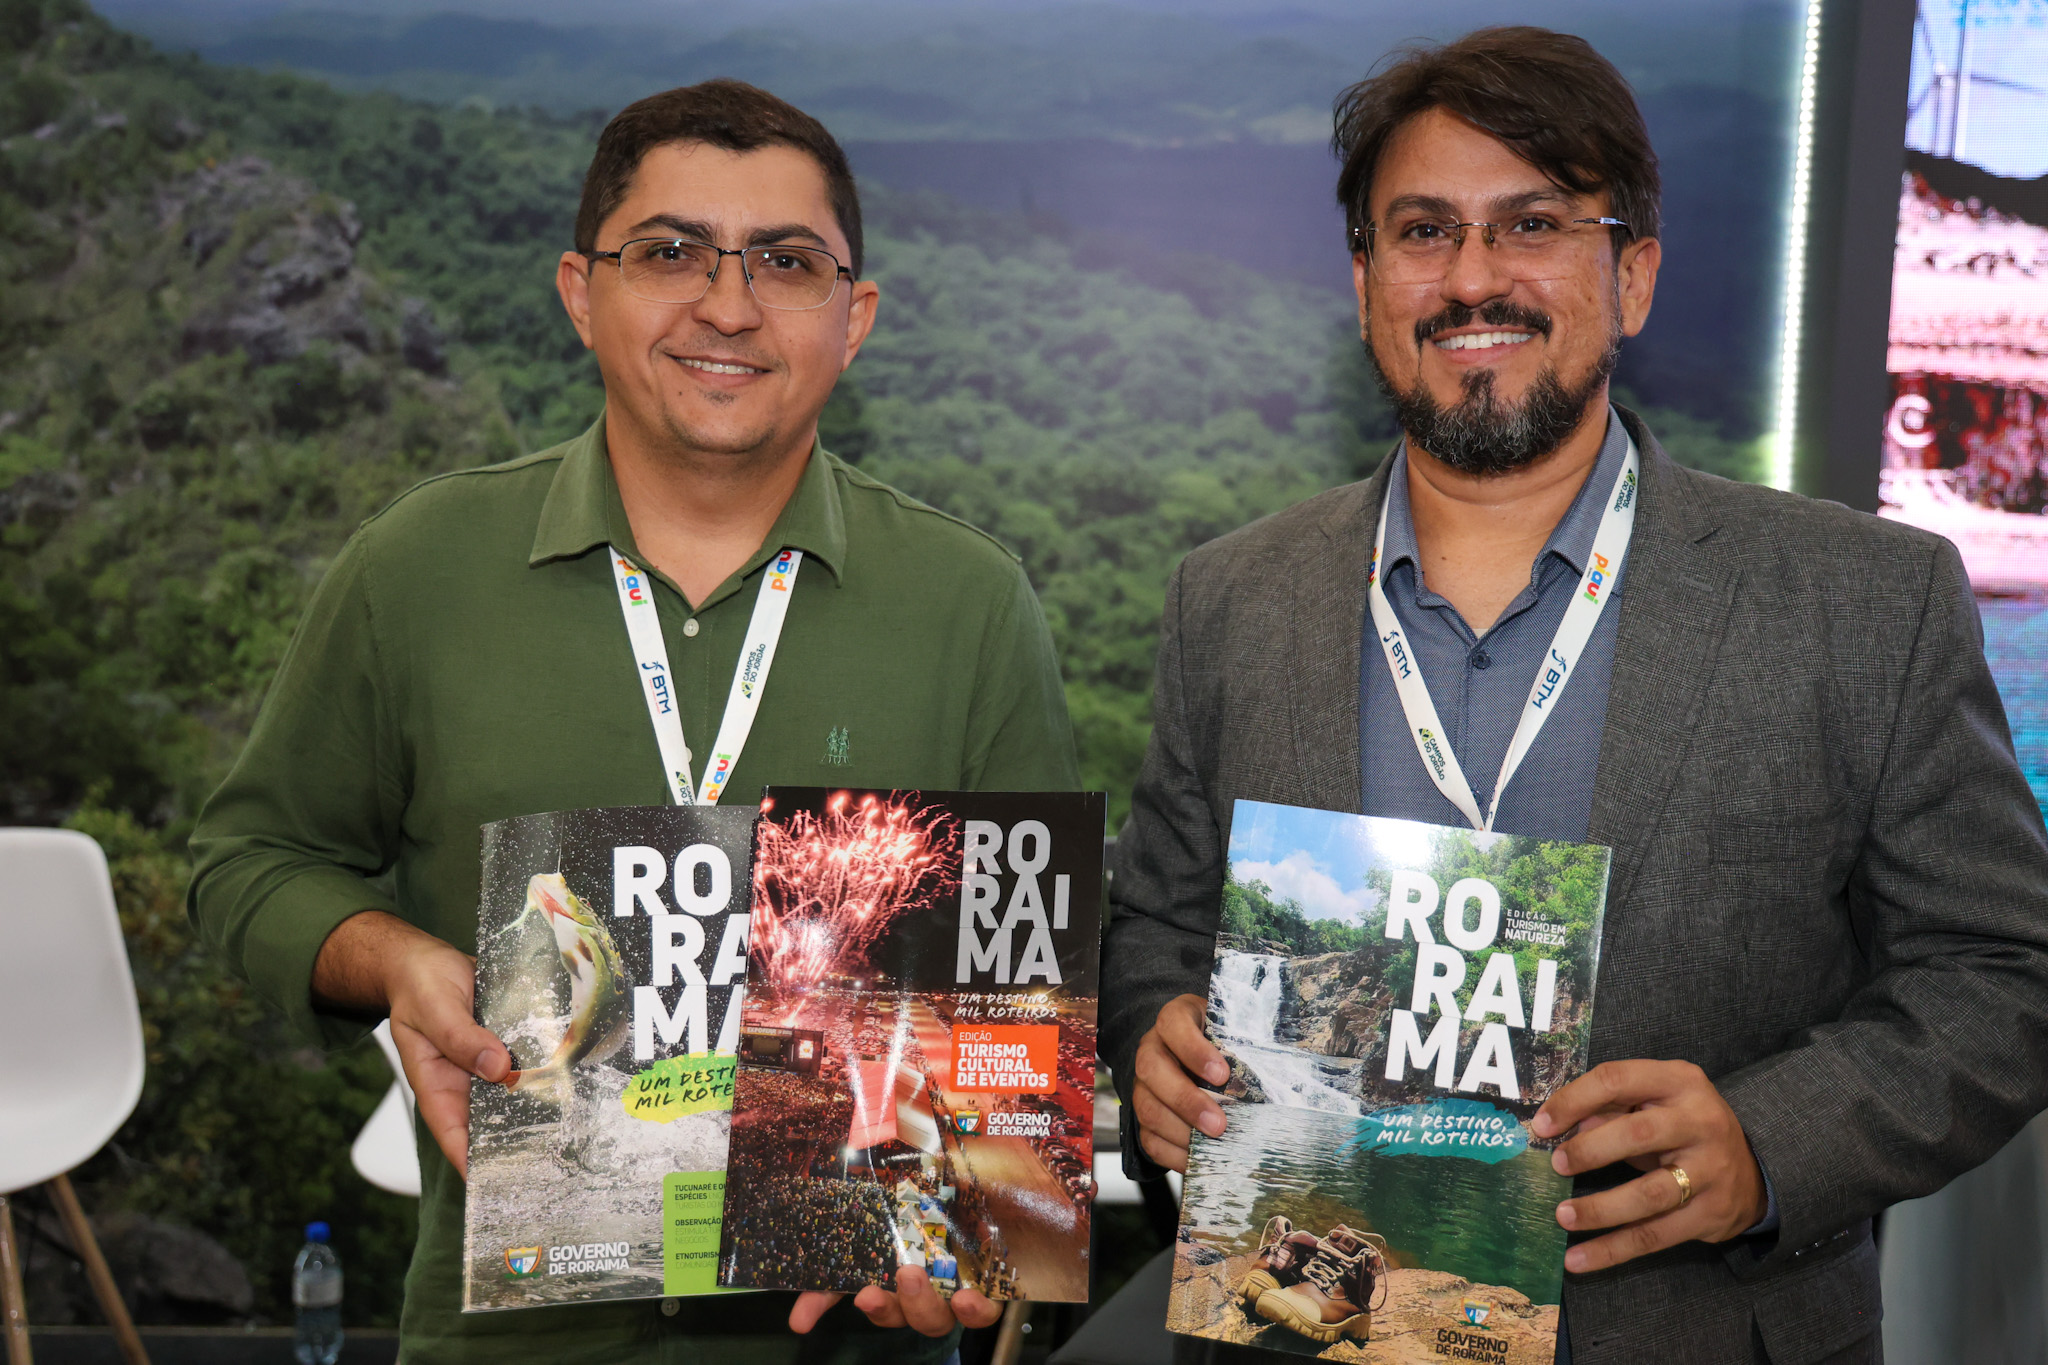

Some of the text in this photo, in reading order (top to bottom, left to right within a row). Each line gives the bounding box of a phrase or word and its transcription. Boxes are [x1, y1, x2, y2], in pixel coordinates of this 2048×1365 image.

[769, 550, 792, 592] piau
[743, 651, 756, 681] CAMPOS
[749, 643, 766, 683] DO JORDÃO
[1392, 641, 1412, 680] BTM
[652, 675, 672, 714] BTM
[1532, 668, 1561, 709] BTM
[1424, 742, 1445, 781] DO JORDÃO
[1430, 738, 1446, 768] CAMPOS
[962, 818, 1051, 877] RO
[614, 844, 731, 917] RO
[960, 874, 1070, 930] RAI
[1384, 869, 1501, 952] RO
[1507, 908, 1548, 922] EDIÇÃO
[1506, 919, 1567, 935] TURISMO EM
[1504, 928, 1566, 947] NATUREZA
[955, 928, 1062, 985] MA
[1411, 942, 1558, 1033] RAI
[958, 993, 984, 1005] UM
[954, 1004, 1058, 1019] MIL ROTEIROS
[959, 1030, 992, 1043] EDIÇÃO
[958, 1044, 1028, 1060] TURISMO
[1384, 1009, 1521, 1100] MA
[957, 1058, 1034, 1074] CULTURAL
[640, 1077, 671, 1092] UM
[956, 1072, 1050, 1088] DE EVENTOS
[635, 1092, 675, 1110] MIL
[987, 1112, 1052, 1127] GOVERNO
[1383, 1113, 1416, 1128] UM
[986, 1125, 1051, 1138] DE RORAIMA
[1377, 1129, 1516, 1149] MIL ROTEIROS
[675, 1183, 711, 1192] TUCUNARÉ
[675, 1216, 721, 1227] OBSERVAÇÃO
[549, 1241, 630, 1262] GOVERNO
[548, 1258, 630, 1276] DE RORAIMA
[1436, 1328, 1509, 1356] GOVERNO
[1436, 1344, 1451, 1357] DE
